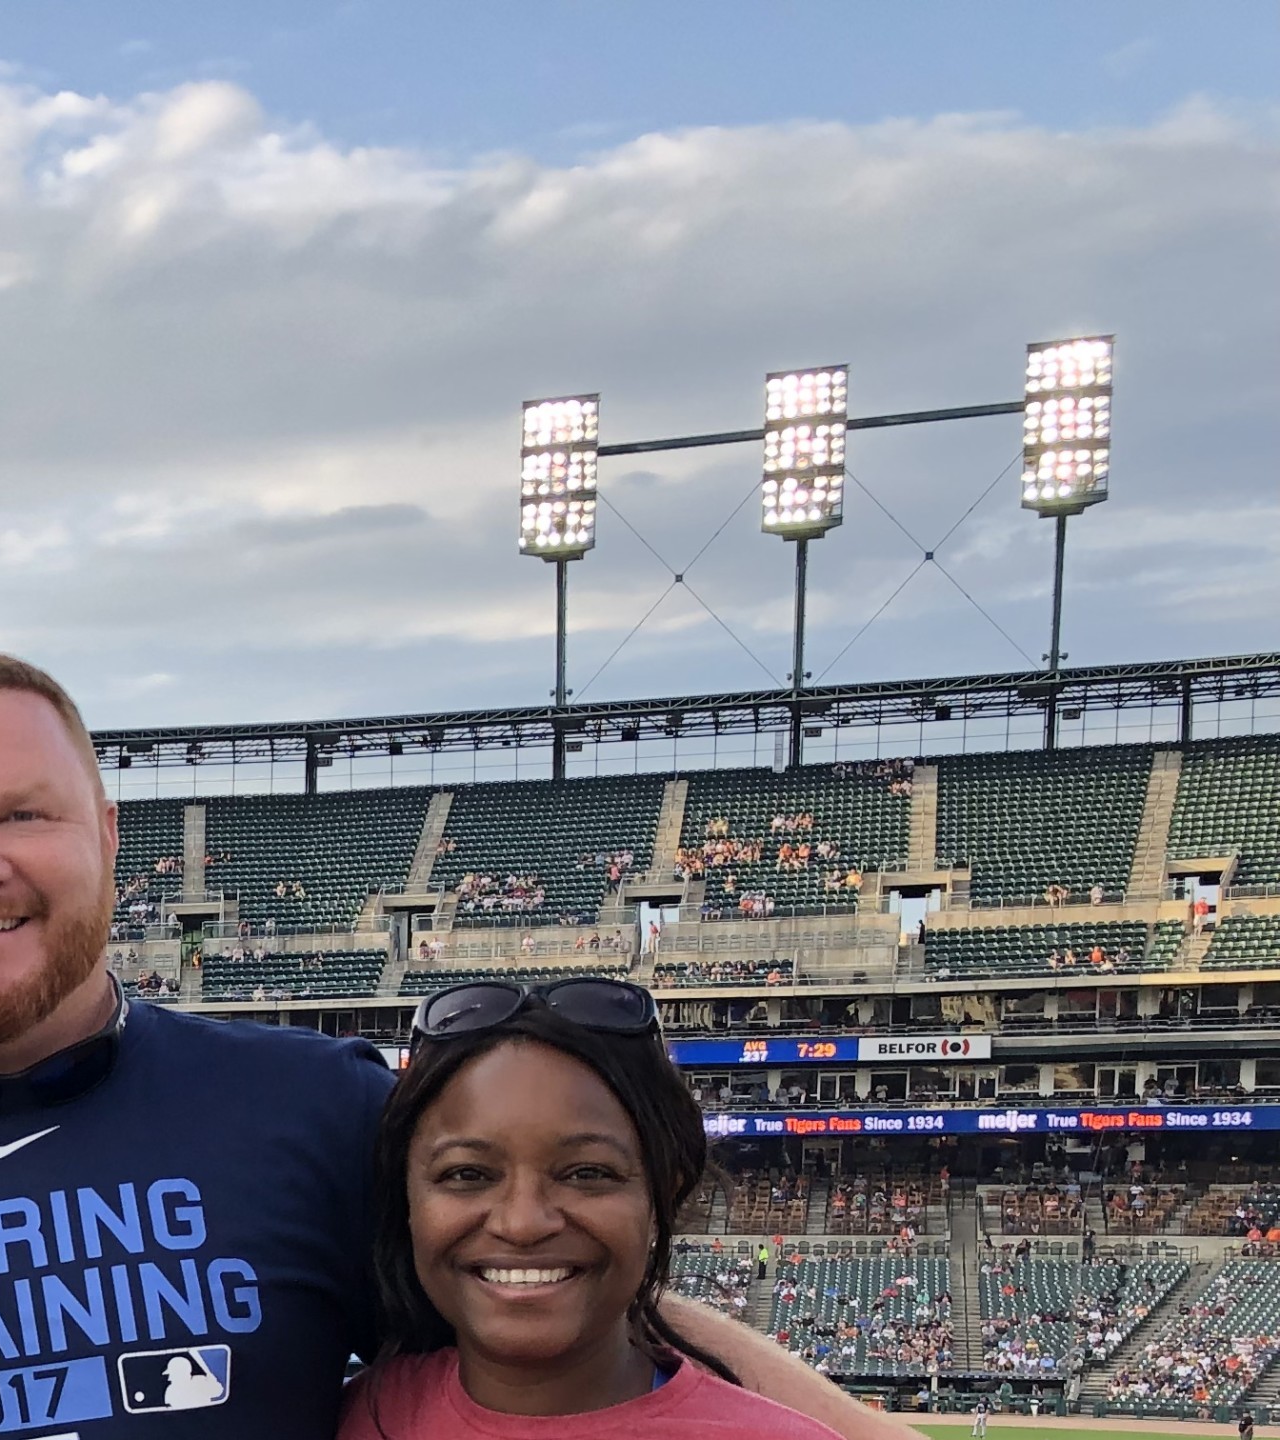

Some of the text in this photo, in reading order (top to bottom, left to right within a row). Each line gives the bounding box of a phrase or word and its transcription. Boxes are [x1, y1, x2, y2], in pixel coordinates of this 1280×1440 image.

[743, 1041, 767, 1051] AVG
[797, 1043, 837, 1058] 7:29
[877, 1042, 937, 1054] BELFOR
[739, 1050, 768, 1062] .237
[703, 1113, 944, 1136] eijer True Tigers Fans Since 1934
[977, 1110, 1252, 1133] meijer True Tigers Fans Since 1934
